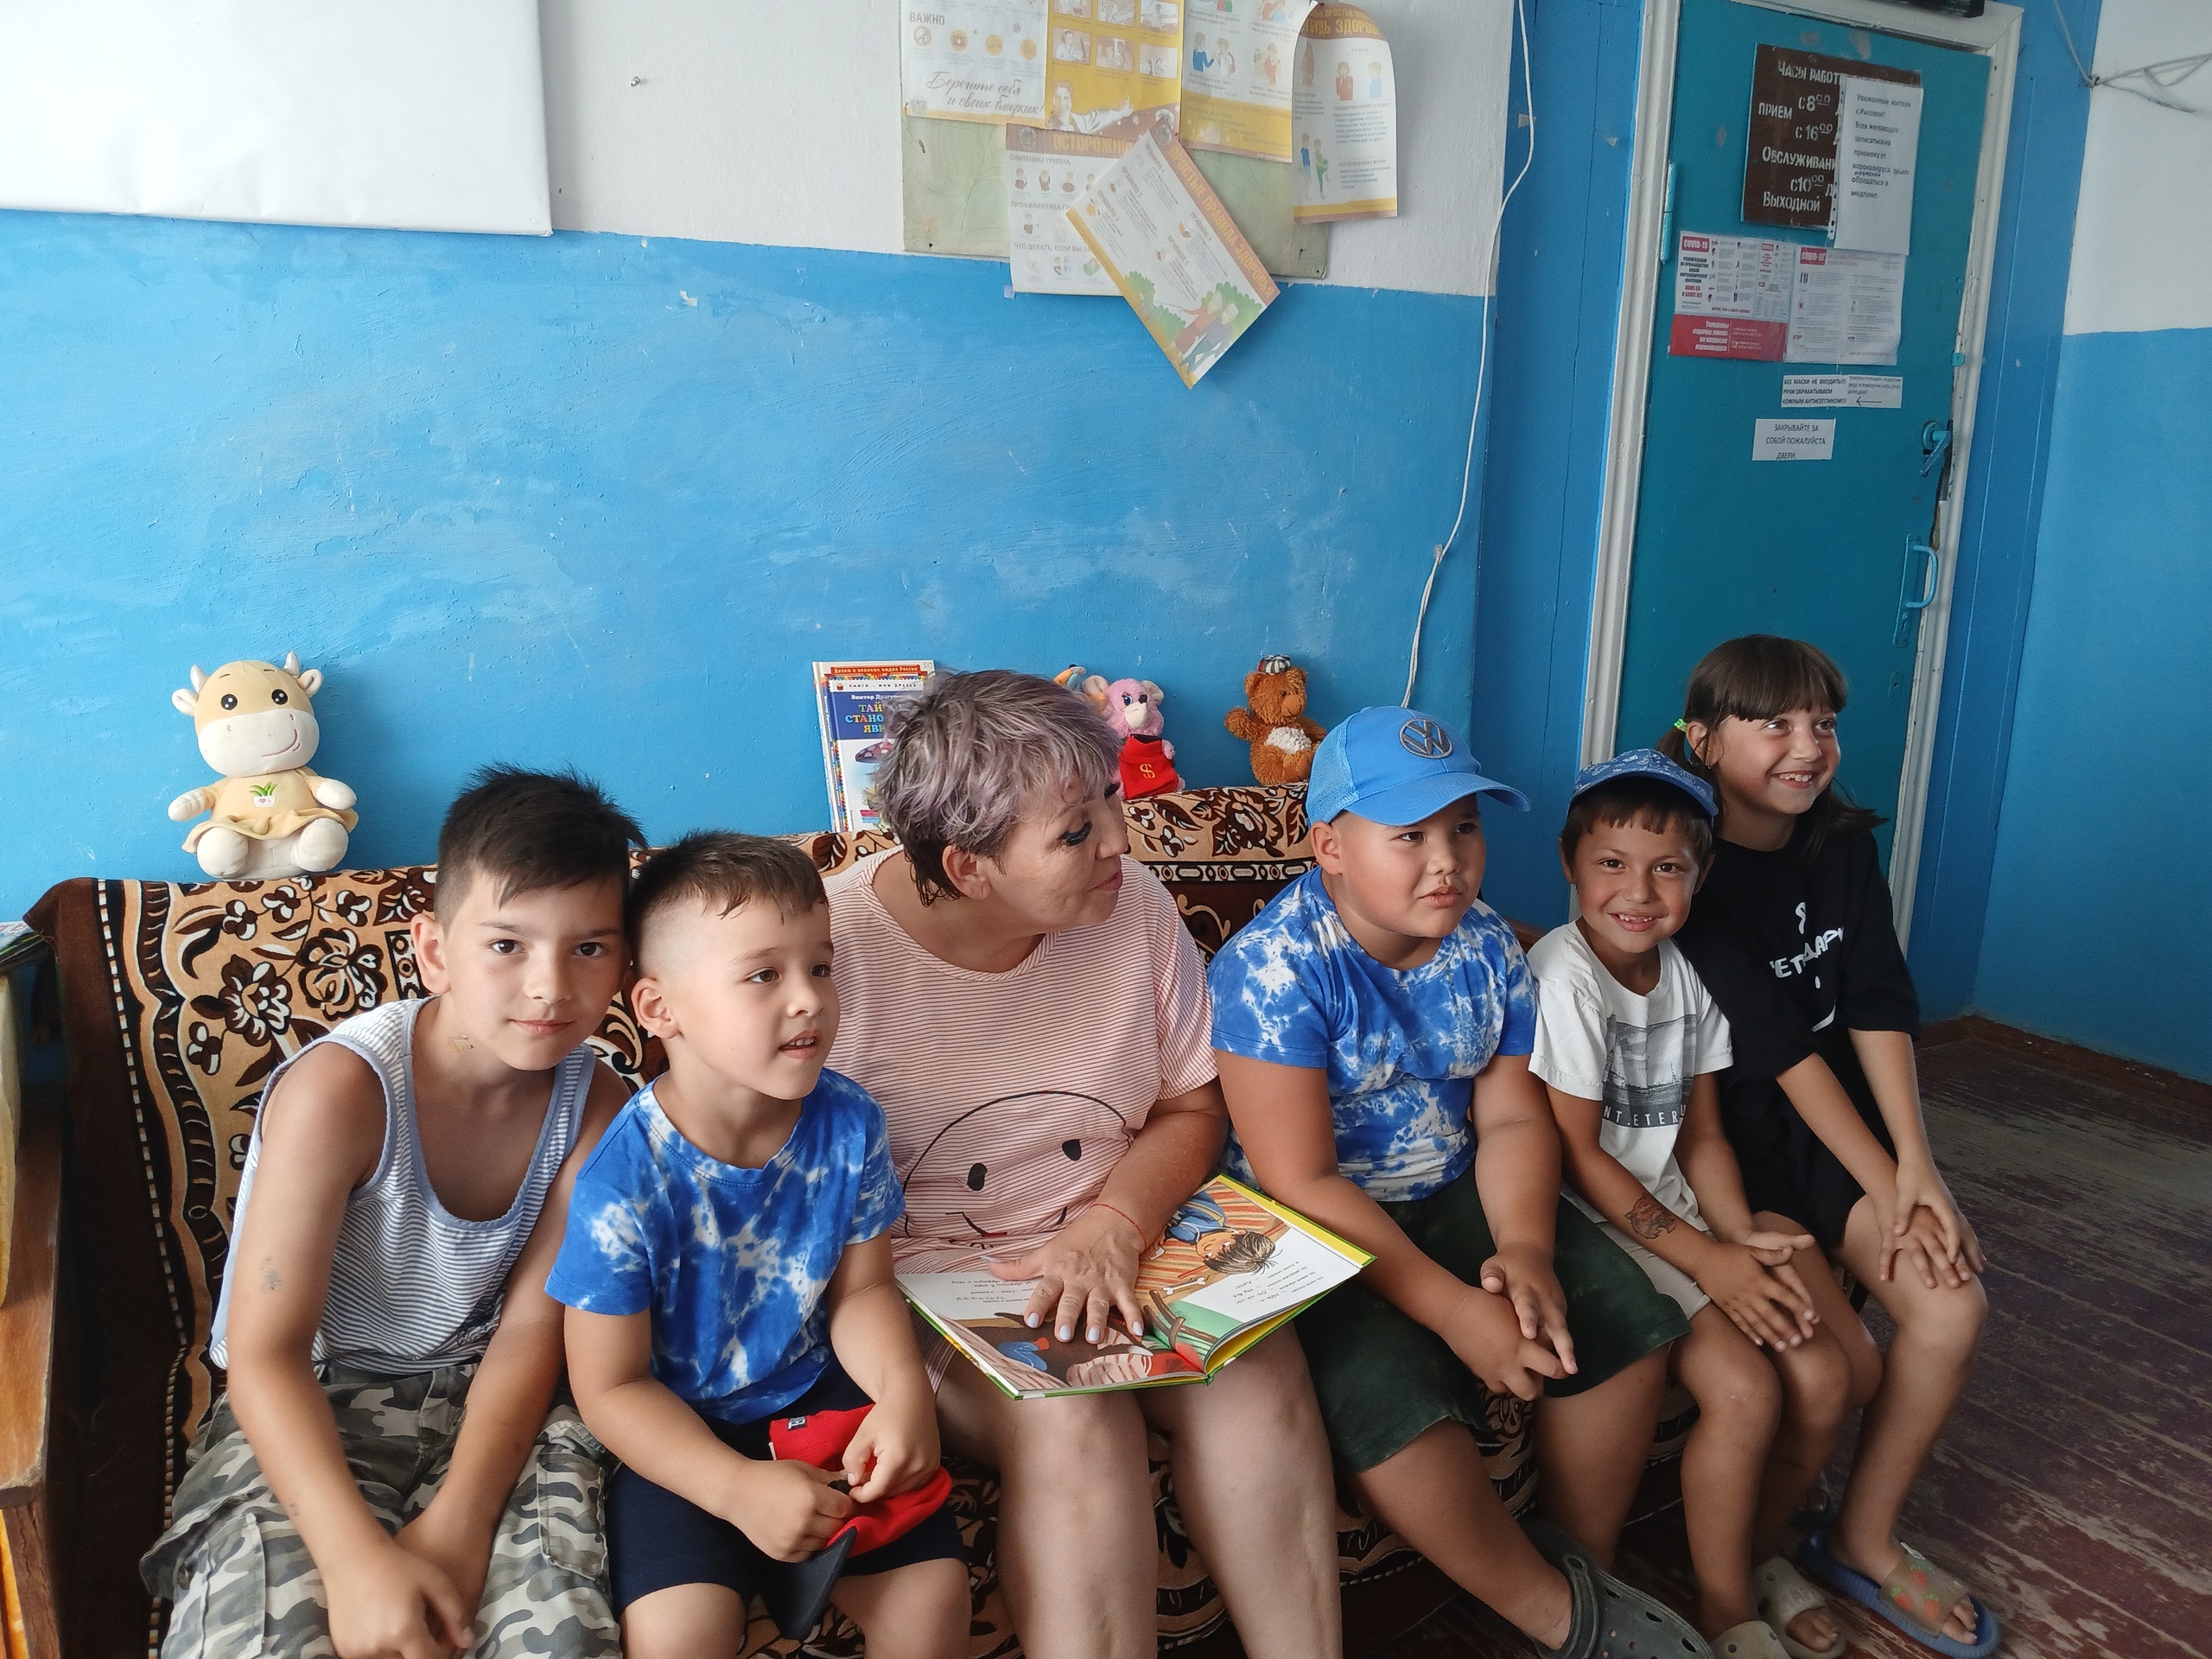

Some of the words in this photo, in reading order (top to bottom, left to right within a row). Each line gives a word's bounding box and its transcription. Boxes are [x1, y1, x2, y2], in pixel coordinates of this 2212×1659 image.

[909, 11, 945, 26] ВАЖНО
[1809, 68, 1840, 85] РАБОТ
[925, 71, 995, 96] Берегите
[997, 79, 1022, 96] себя
[947, 96, 956, 105] и
[958, 92, 992, 109] своих
[1857, 94, 1890, 105] Уважаемые
[1758, 102, 1793, 120] ПРИЕМ
[1855, 121, 1867, 130] Всех
[1868, 124, 1899, 134] желающих
[1008, 154, 1045, 163] СИМПТОМЫ
[1122, 166, 1140, 193] ПРАВИЛО
[1011, 200, 1061, 210] ПРОФИЛАКТИКА
[1097, 190, 1117, 218] ПРАВИЛО
[1167, 235, 1185, 262] ПРАВИЛО
[1203, 195, 1238, 247] ПРАВИЛА
[1235, 244, 1274, 298] ЗДОРОВЬЯ
[1683, 238, 1708, 250] COVID-19
[1802, 251, 1827, 262] COVID-19
[1774, 423, 1810, 432] ЗАКРЫВАЙТЕ
[1765, 435, 1786, 444] СОБОЙ
[1786, 436, 1826, 445] ПОЖАЛУЙСТА
[858, 701, 883, 713] ТАЙ
[844, 715, 884, 723] СТАНО
